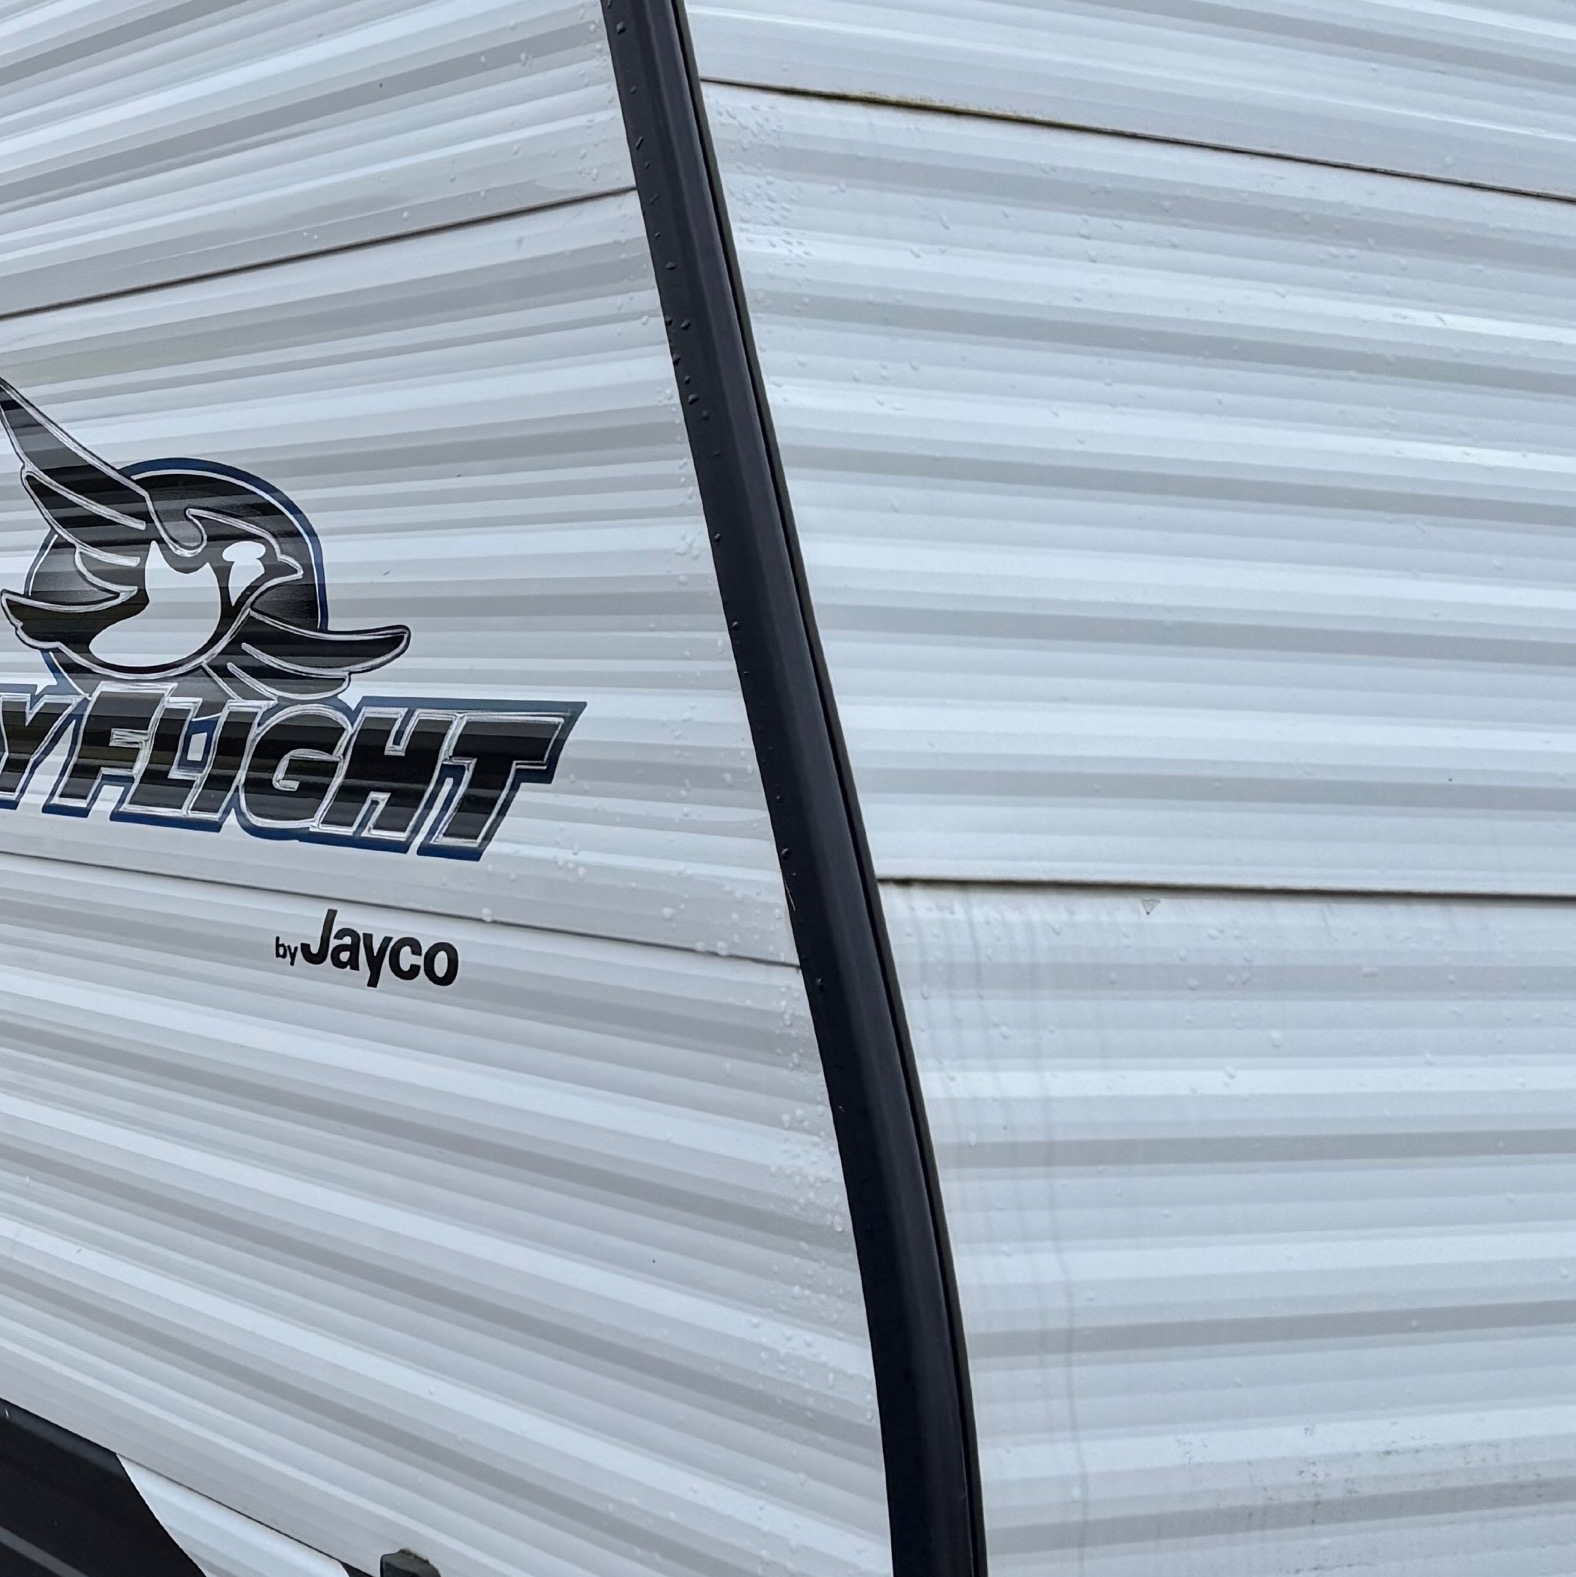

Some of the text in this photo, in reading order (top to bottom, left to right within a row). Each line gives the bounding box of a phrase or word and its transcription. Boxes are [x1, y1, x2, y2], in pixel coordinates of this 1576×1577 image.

[42, 681, 587, 861] FLIGHT
[275, 908, 459, 988] by Jayco
